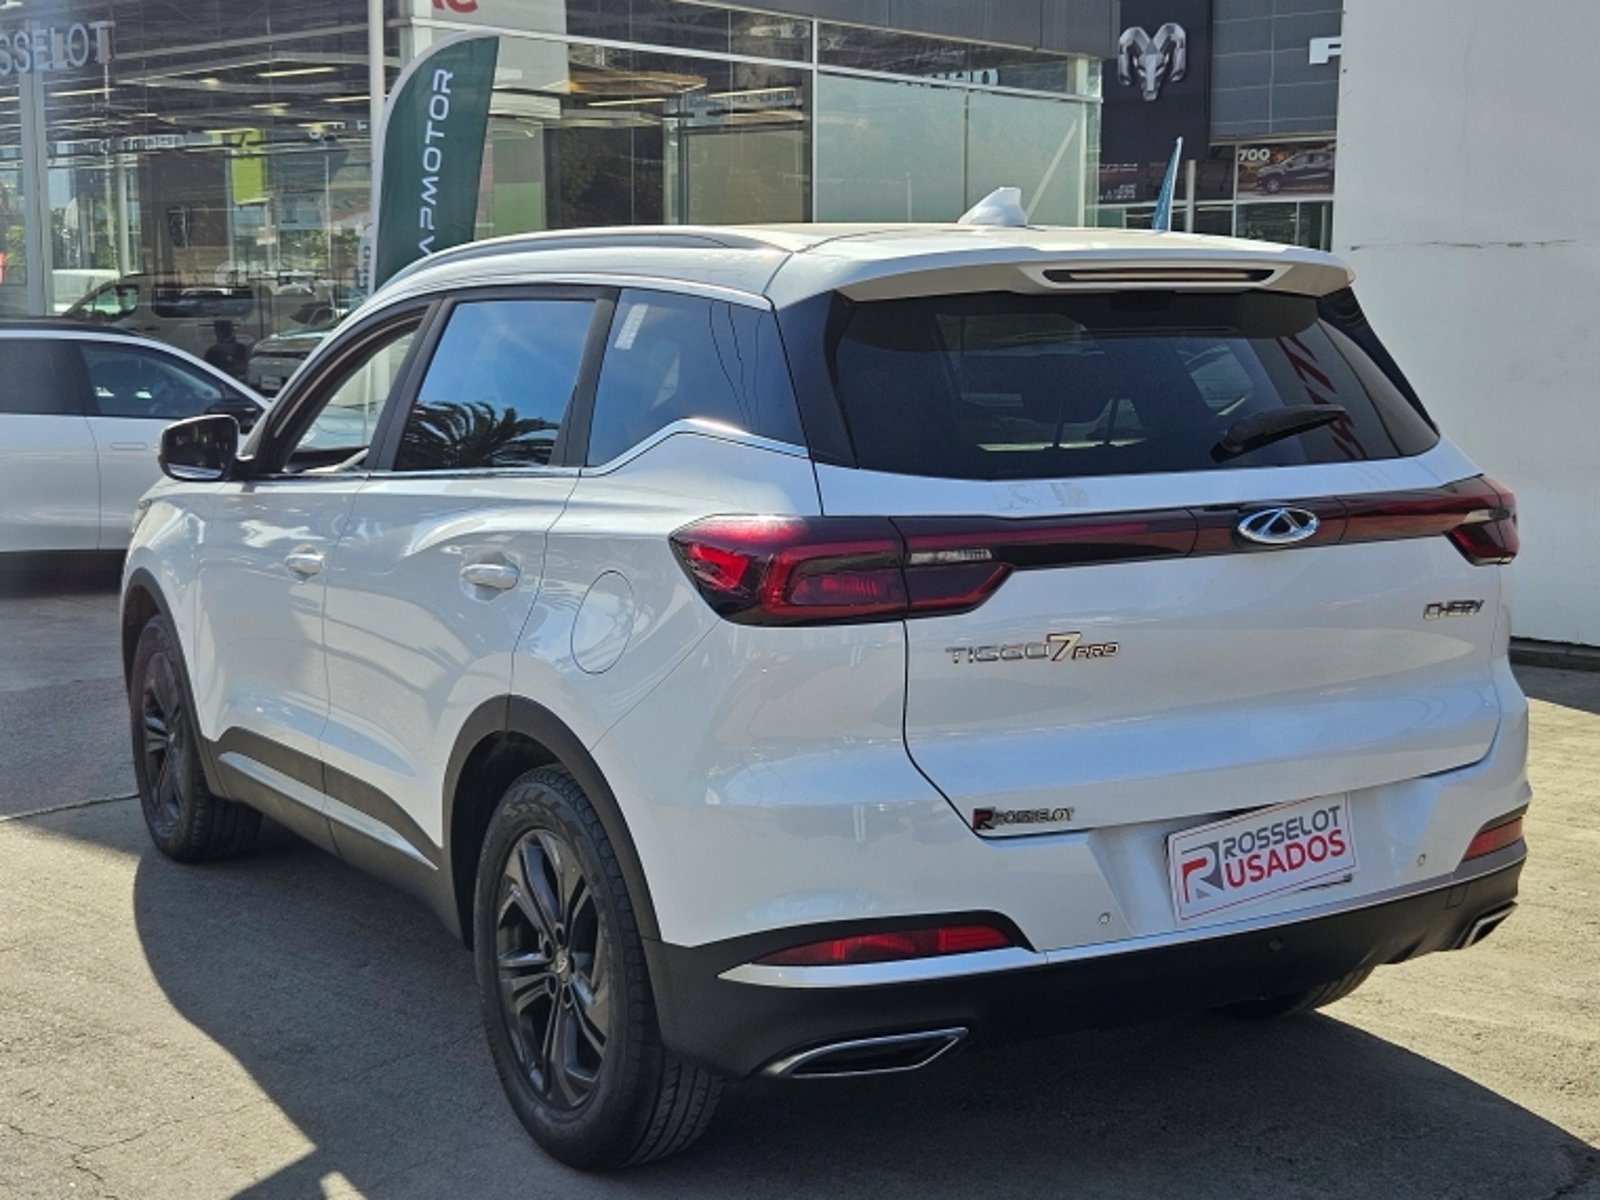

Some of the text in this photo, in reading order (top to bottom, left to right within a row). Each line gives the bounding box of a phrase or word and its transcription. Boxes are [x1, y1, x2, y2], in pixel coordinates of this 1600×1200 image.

[1239, 148, 1271, 162] 700
[1423, 599, 1485, 620] CHERY
[944, 644, 1048, 664] TIGGO
[1223, 806, 1341, 860] ROSSELOT
[1226, 829, 1346, 889] USADOS
